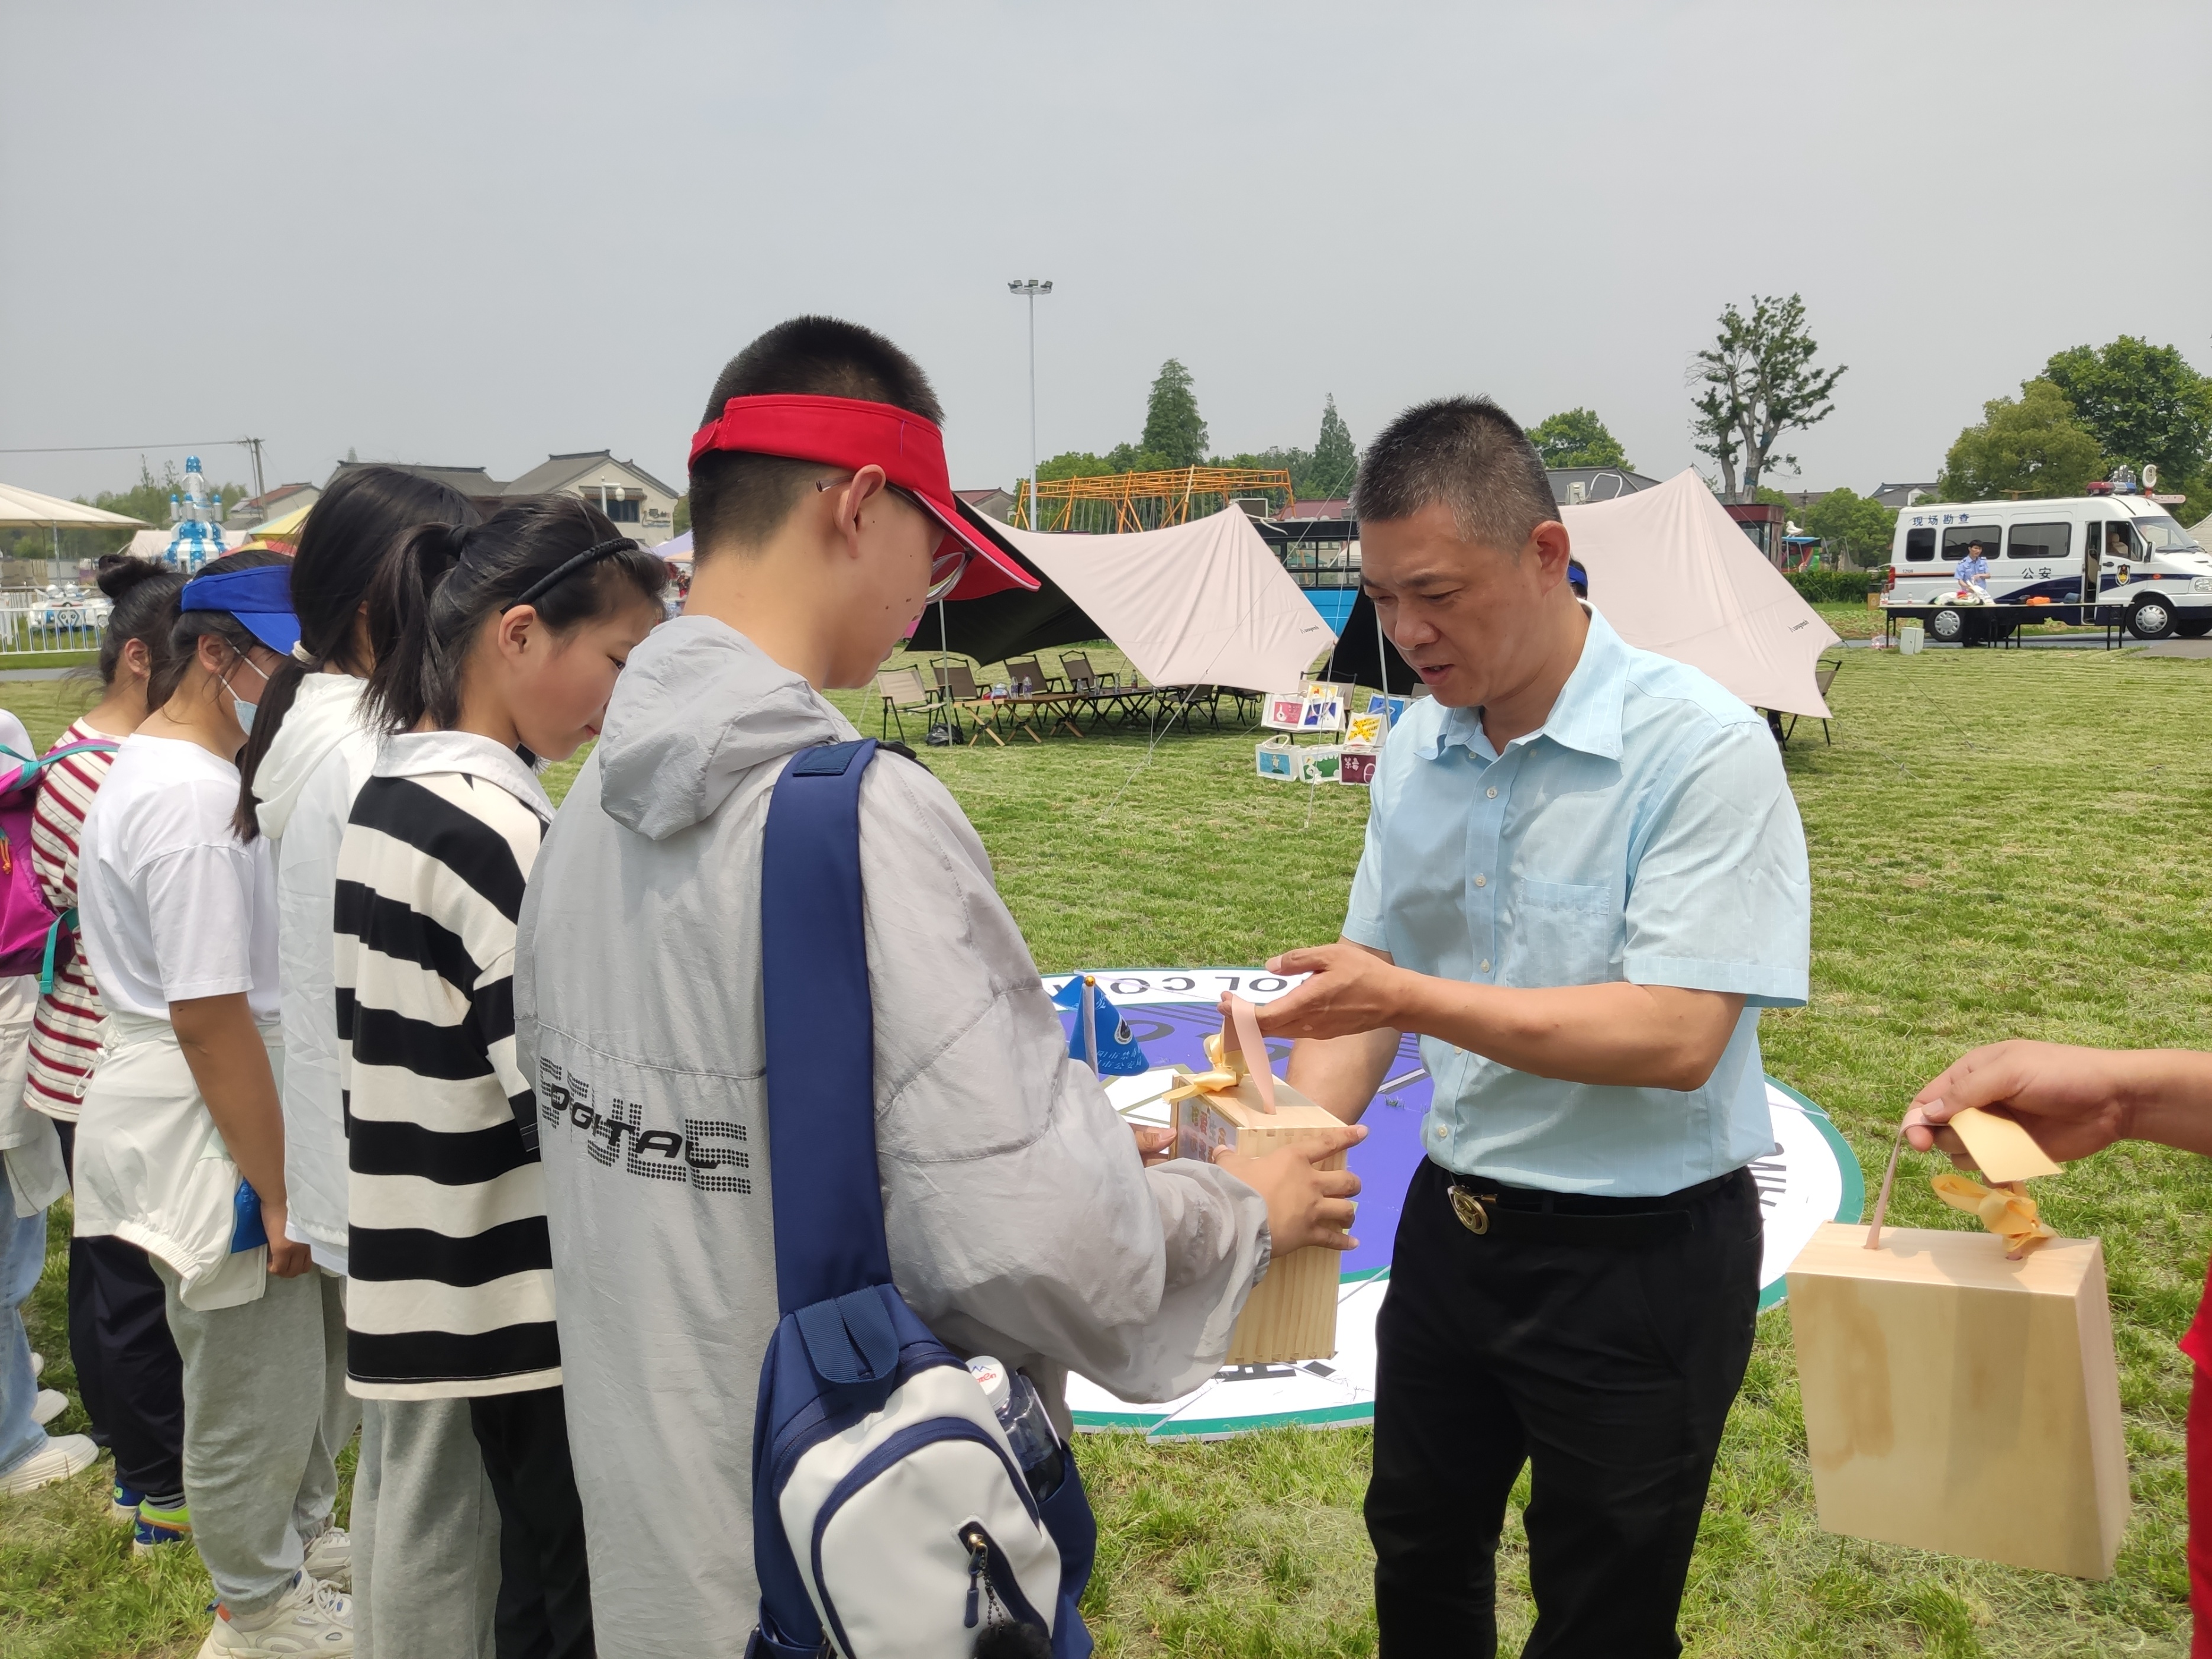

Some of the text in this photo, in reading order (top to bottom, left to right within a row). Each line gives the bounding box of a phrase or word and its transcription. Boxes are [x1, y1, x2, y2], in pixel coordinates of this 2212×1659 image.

[1912, 513, 1969, 527] 现场勘查
[2022, 567, 2052, 579] 公安
[1344, 757, 1360, 771] 禁毒
